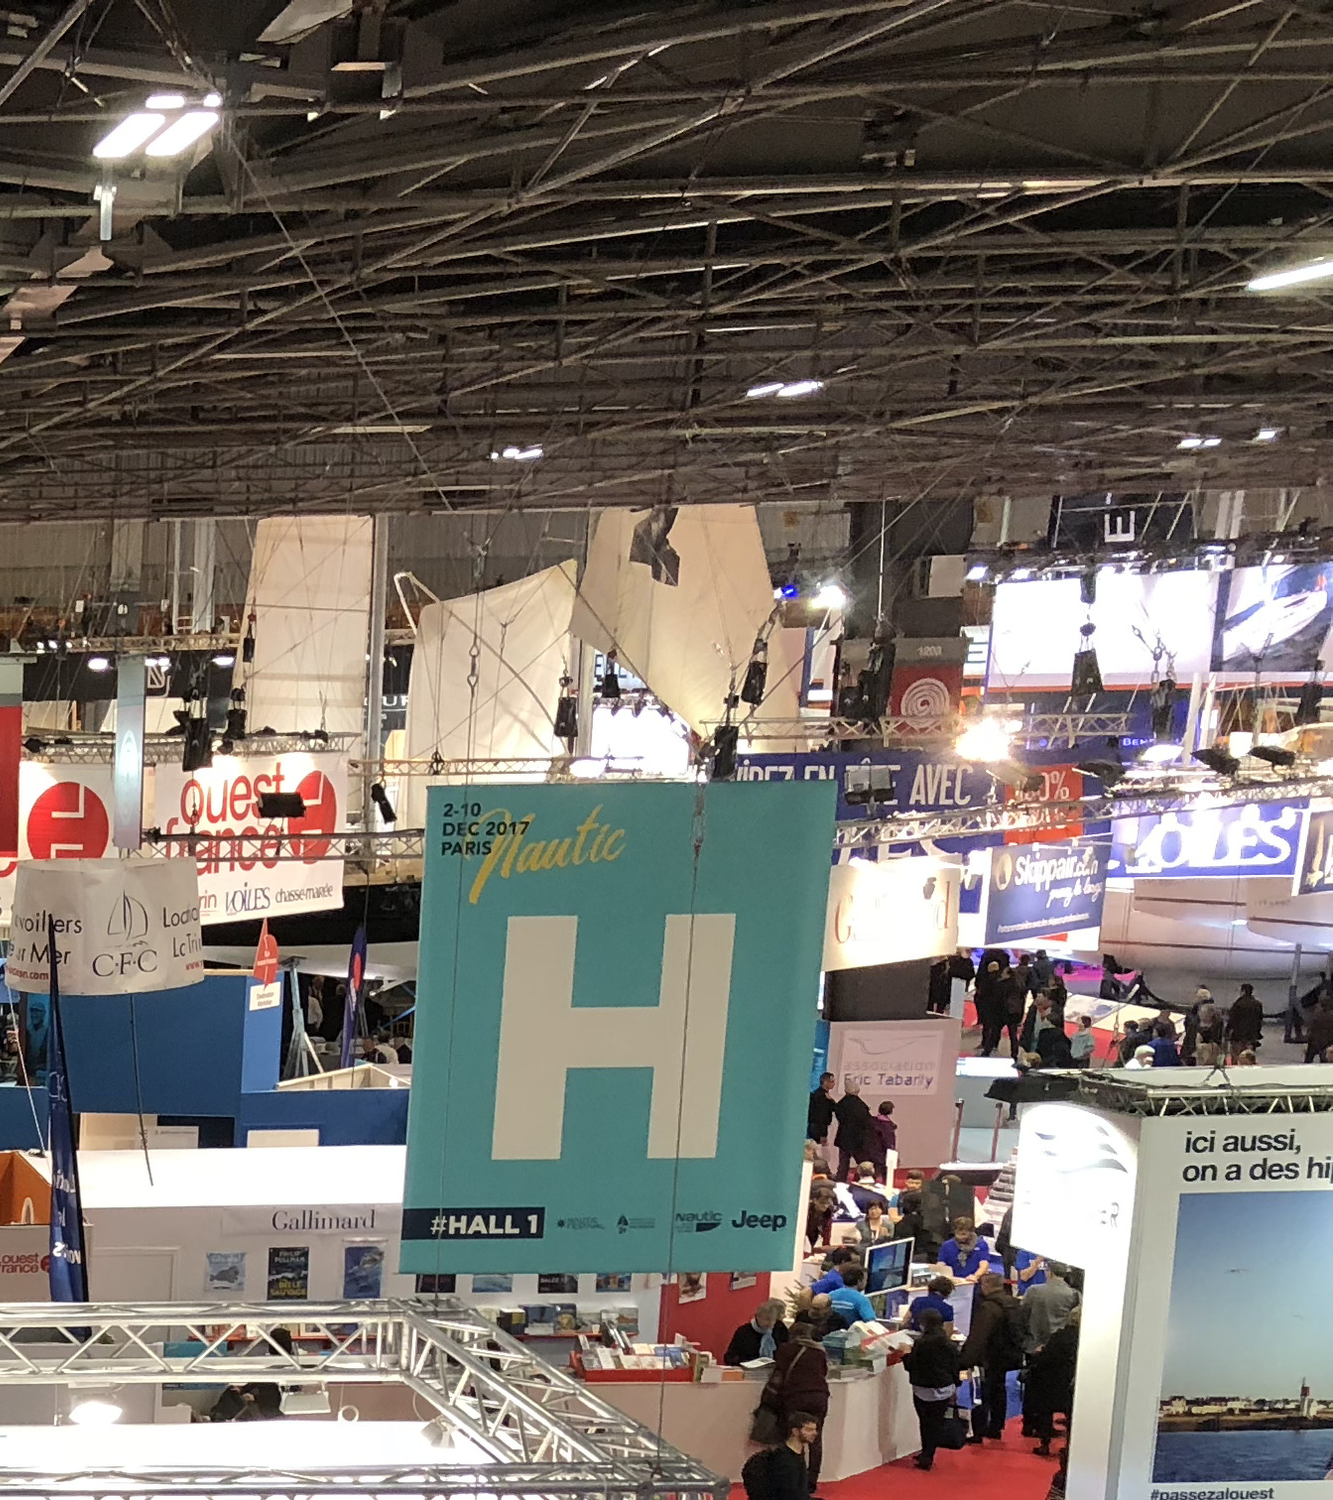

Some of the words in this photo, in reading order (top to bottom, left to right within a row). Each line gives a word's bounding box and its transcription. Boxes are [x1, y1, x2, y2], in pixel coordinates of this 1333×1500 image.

[180, 763, 285, 825] ouest
[909, 765, 973, 806] AVEC
[443, 803, 481, 817] 2-10
[442, 821, 480, 836] DEC
[486, 821, 530, 836] 2017
[441, 840, 492, 855] PARIS
[468, 805, 626, 904] Nautic
[491, 913, 736, 1160] H
[876, 1072, 934, 1092] Tabarly
[1185, 1130, 1216, 1153] ici
[1221, 1128, 1302, 1158] aussi,
[1182, 1161, 1219, 1183] on
[1224, 1162, 1242, 1182] a
[1248, 1157, 1301, 1182] des
[272, 1208, 376, 1231] Gallimard
[430, 1215, 521, 1236] #HALL
[527, 1214, 540, 1234] 1
[731, 1210, 787, 1232] Jeep
[2, 1253, 39, 1264] ouest
